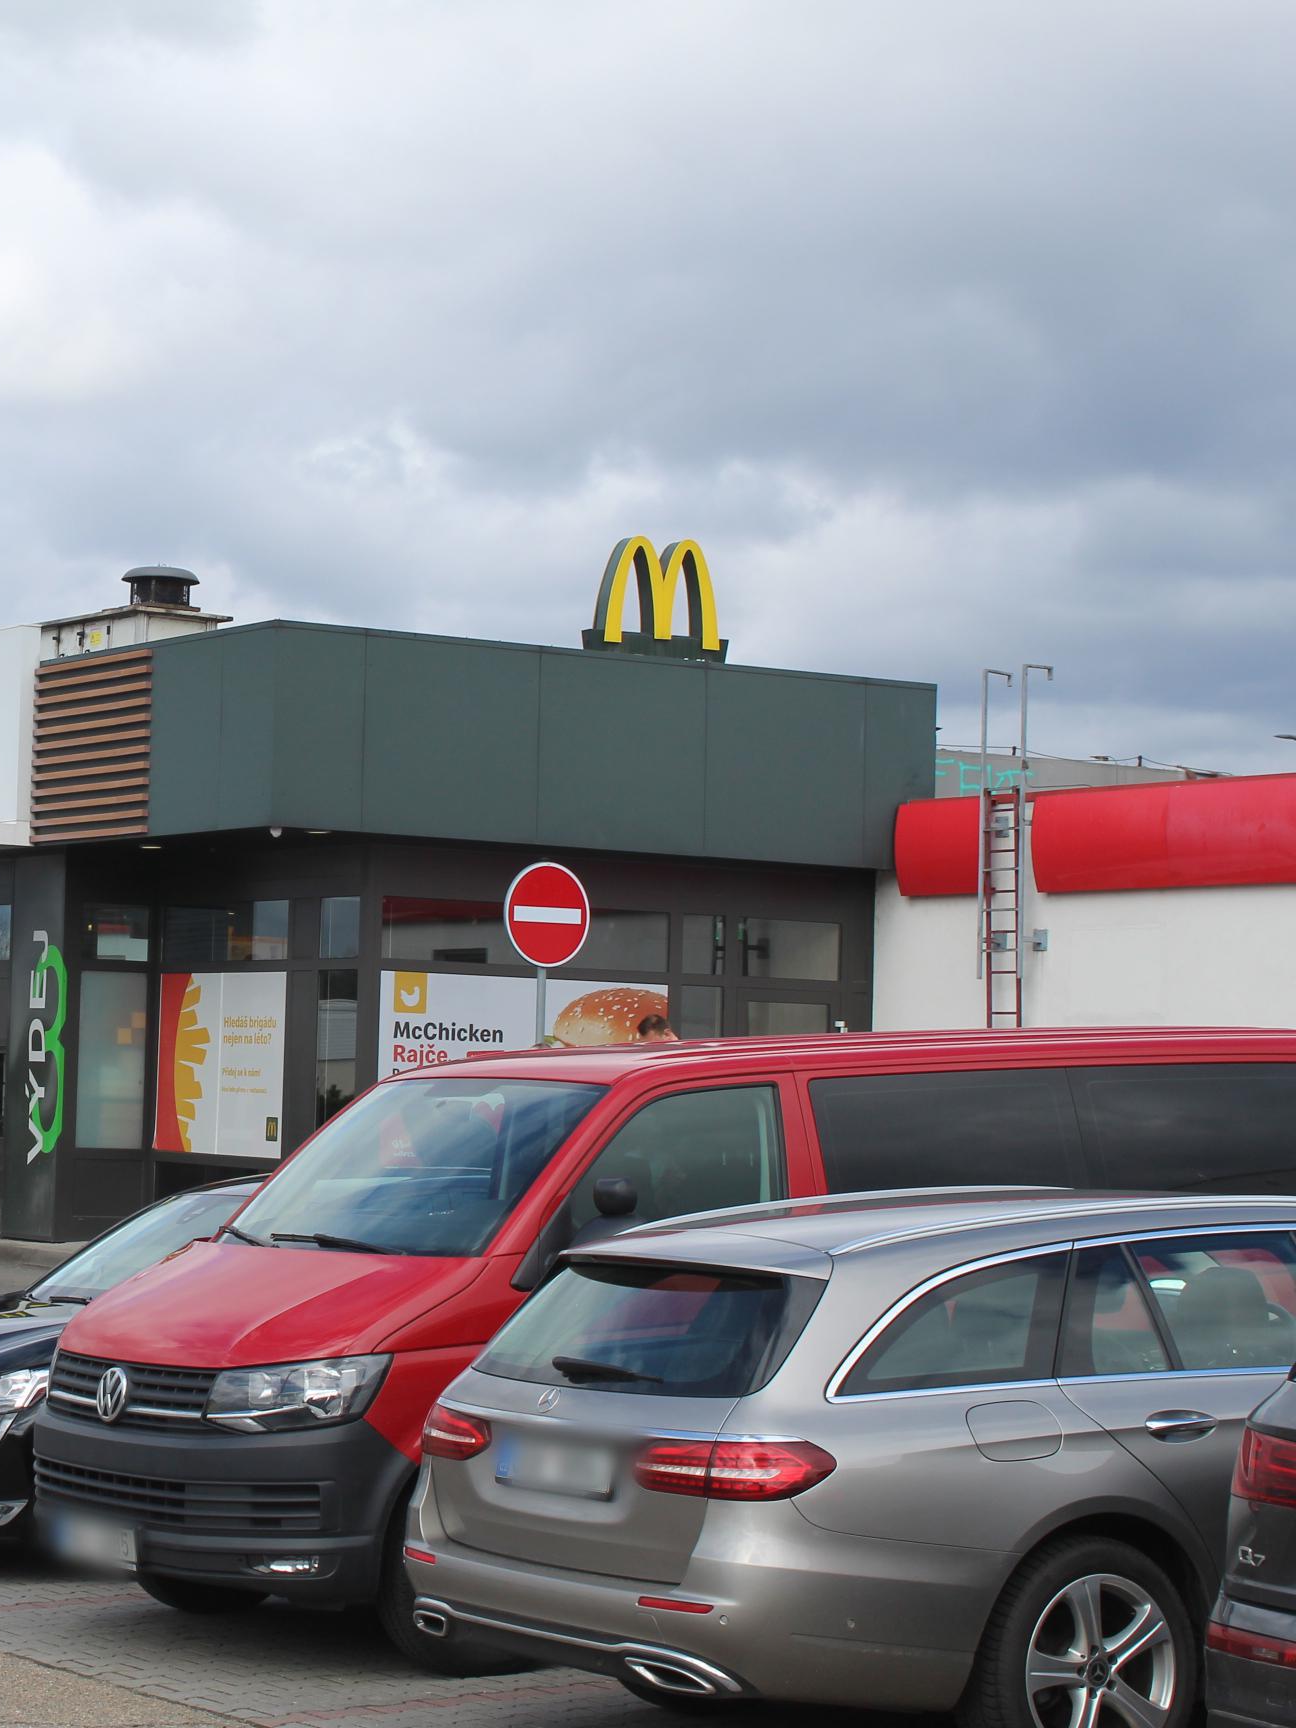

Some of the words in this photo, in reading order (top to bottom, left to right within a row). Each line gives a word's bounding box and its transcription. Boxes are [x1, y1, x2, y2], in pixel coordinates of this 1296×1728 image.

[224, 1016, 248, 1028] Hledáš
[249, 1016, 277, 1031] brigádu
[393, 1021, 504, 1043] McChicken
[223, 1032, 243, 1047] nejen
[244, 1036, 253, 1044] na
[254, 1032, 272, 1044] léto?
[393, 1044, 448, 1069] Rajče
[1238, 1545, 1266, 1567] Q7
